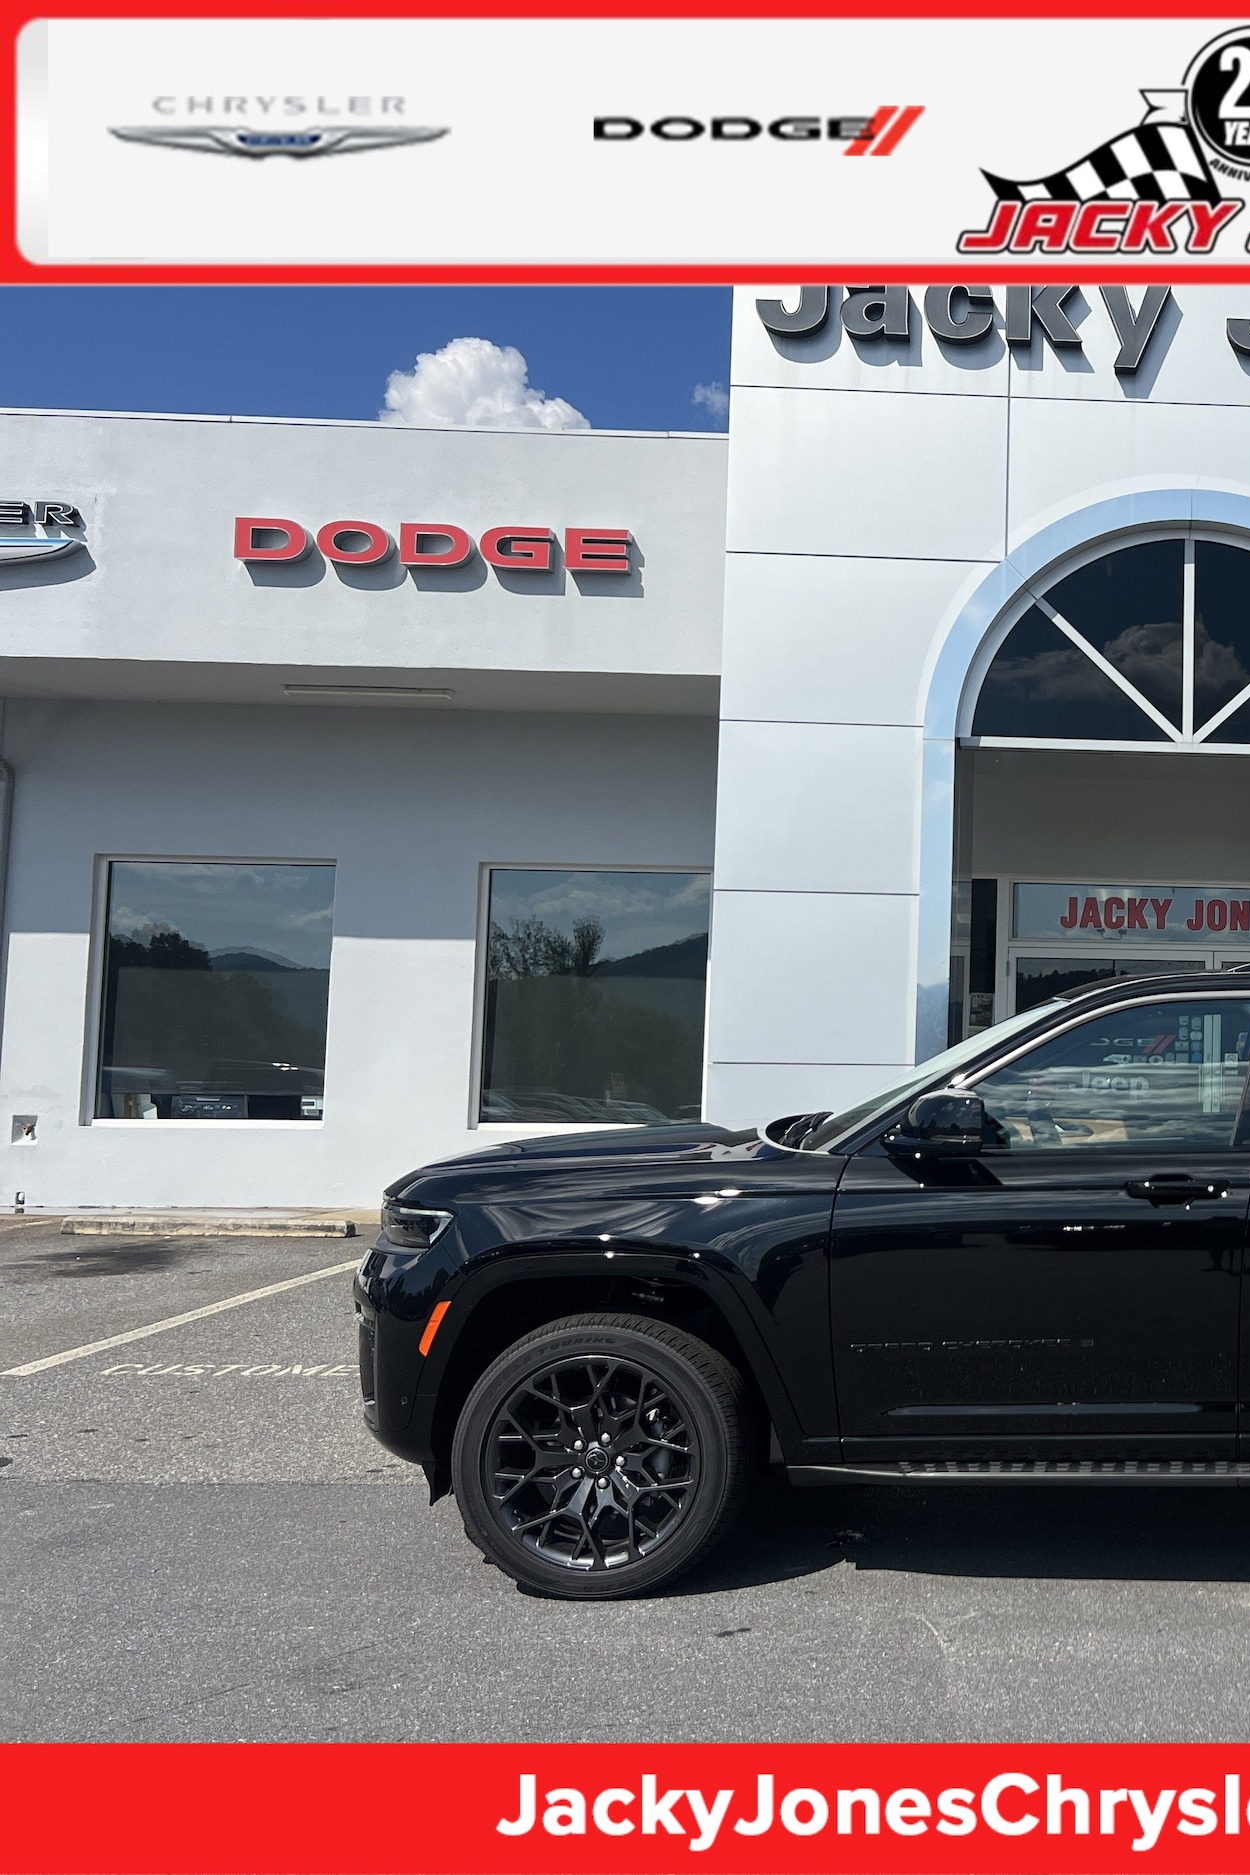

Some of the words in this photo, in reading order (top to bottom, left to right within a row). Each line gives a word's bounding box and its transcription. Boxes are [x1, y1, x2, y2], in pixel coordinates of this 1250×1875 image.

[756, 285, 1172, 375] Jacky
[234, 516, 631, 572] DODGE
[1060, 896, 1171, 931] JACKY
[1069, 1071, 1150, 1101] Jeep
[100, 1363, 361, 1377] CUSTOME
